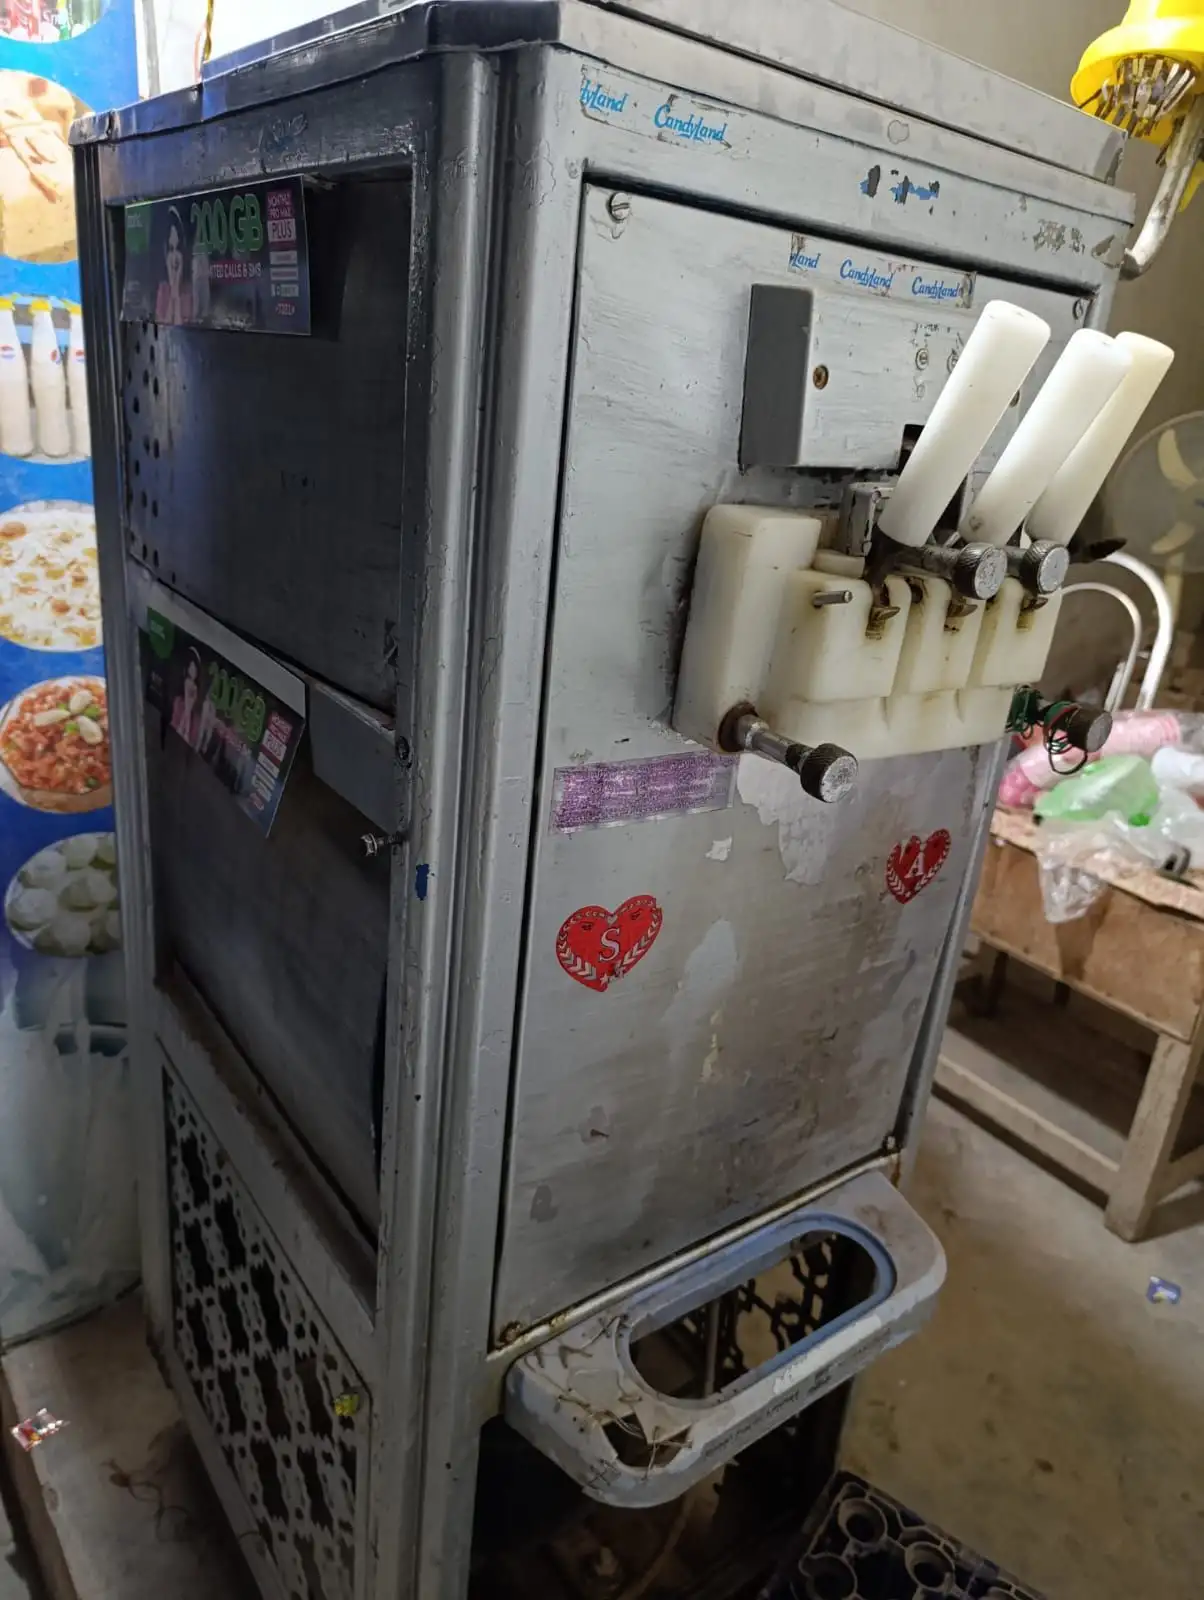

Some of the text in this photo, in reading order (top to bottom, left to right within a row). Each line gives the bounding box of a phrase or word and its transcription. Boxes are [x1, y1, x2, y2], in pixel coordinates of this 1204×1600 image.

[654, 103, 728, 142] CandyLand
[272, 219, 292, 240] PLUS
[840, 259, 895, 288] CandyLand
[911, 276, 960, 299] CandyLand
[904, 851, 925, 879] A
[599, 927, 620, 962] S
